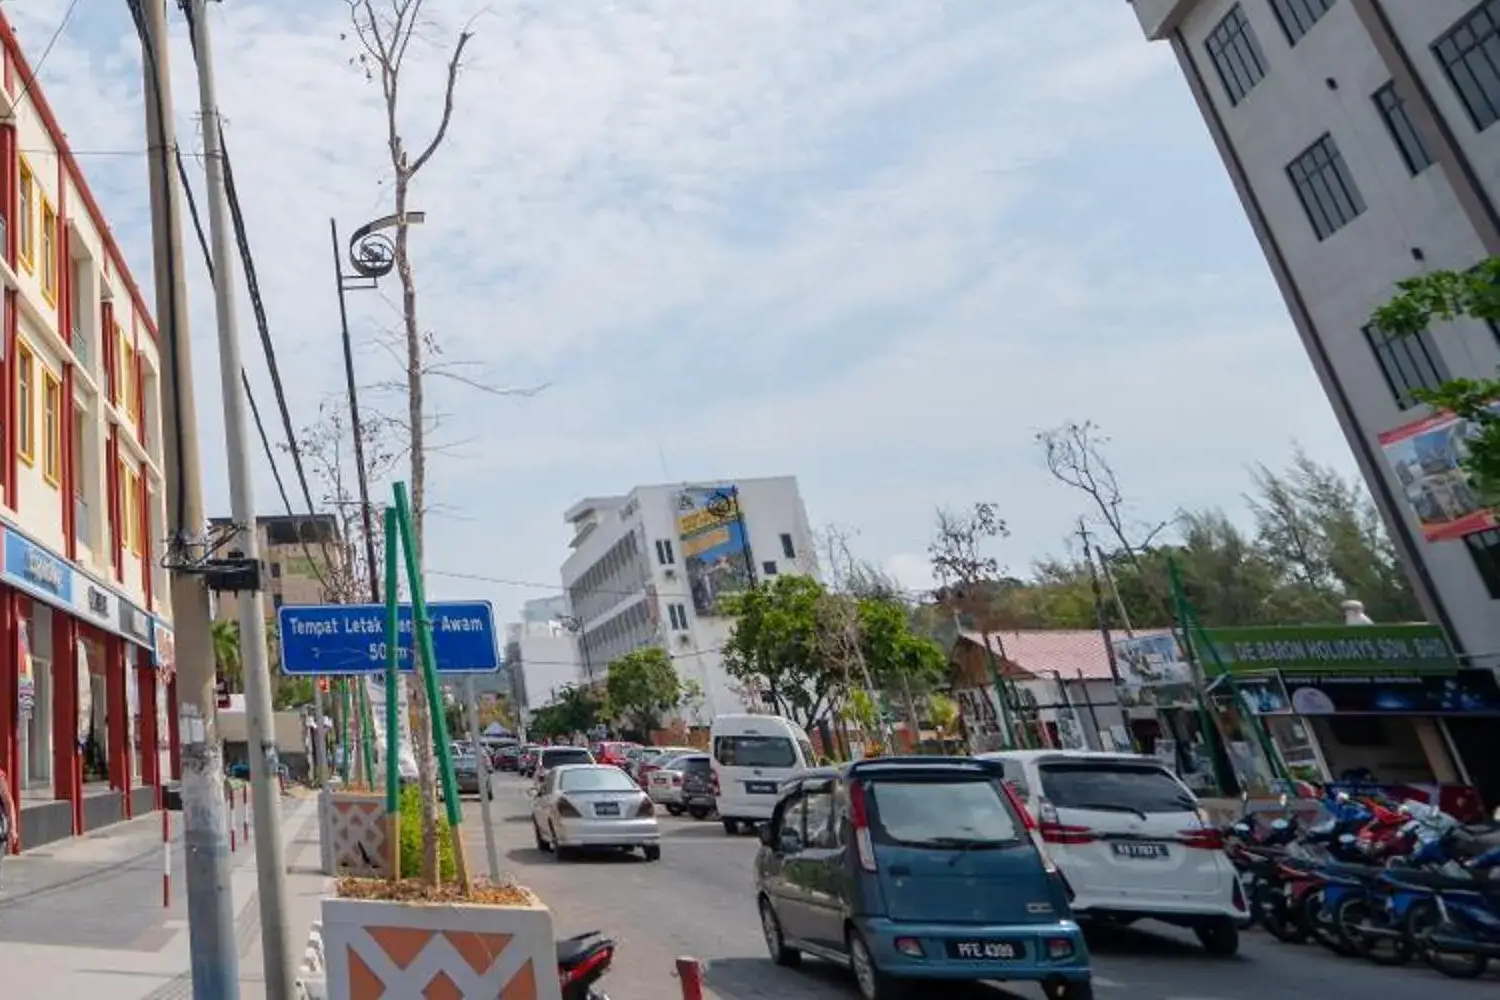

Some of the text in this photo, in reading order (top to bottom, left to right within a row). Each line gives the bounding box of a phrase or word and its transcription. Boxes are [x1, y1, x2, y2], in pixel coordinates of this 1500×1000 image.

[289, 616, 338, 639] Tempat
[345, 616, 383, 633] Letak
[441, 615, 483, 632] Awam
[368, 642, 387, 660] 50
